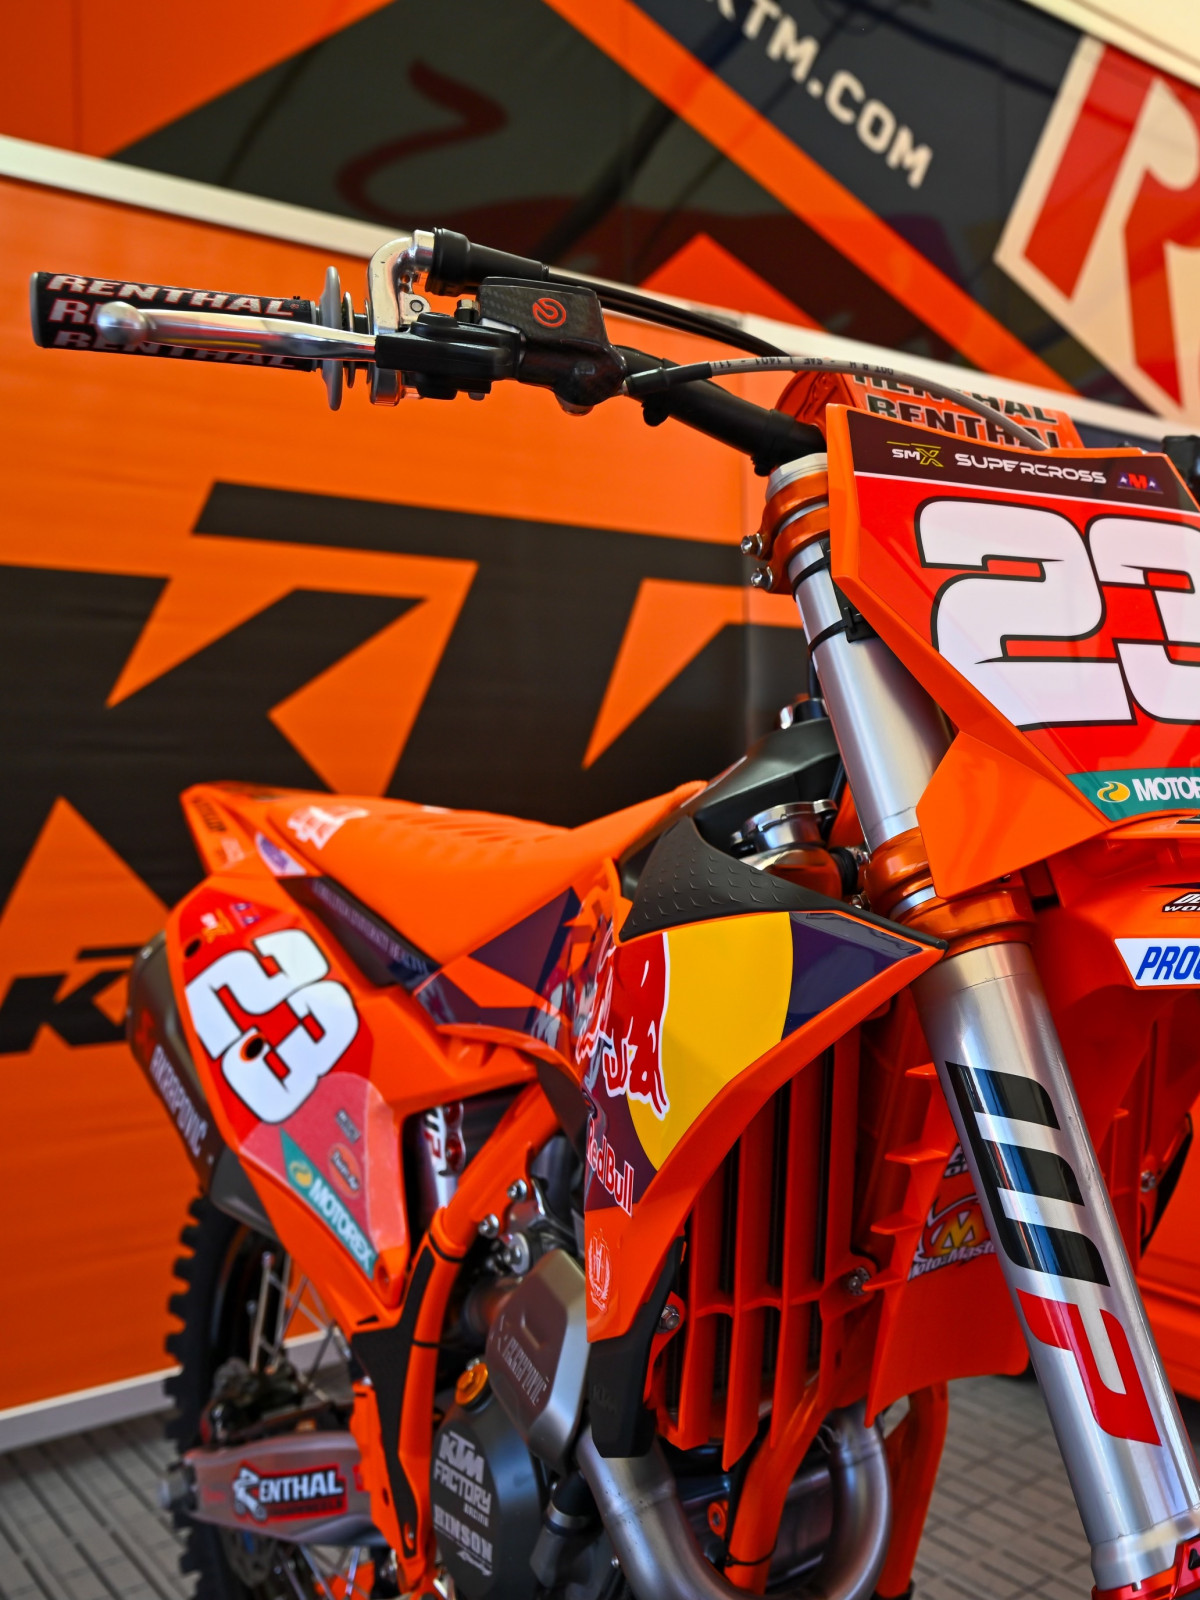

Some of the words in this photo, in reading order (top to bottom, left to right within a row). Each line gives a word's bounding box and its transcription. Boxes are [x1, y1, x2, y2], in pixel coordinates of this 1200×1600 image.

[46, 274, 294, 317] RENTHAL
[891, 446, 944, 468] SMX
[954, 453, 1107, 485] SUPERCROSS
[184, 927, 361, 1124] 23
[604, 1143, 636, 1218] Bull
[308, 1177, 377, 1273] MOTOREX
[944, 1060, 1163, 1447] WP
[438, 1429, 485, 1484] KTM
[433, 1458, 492, 1516] FACTORY
[433, 1503, 494, 1563] HINSON
